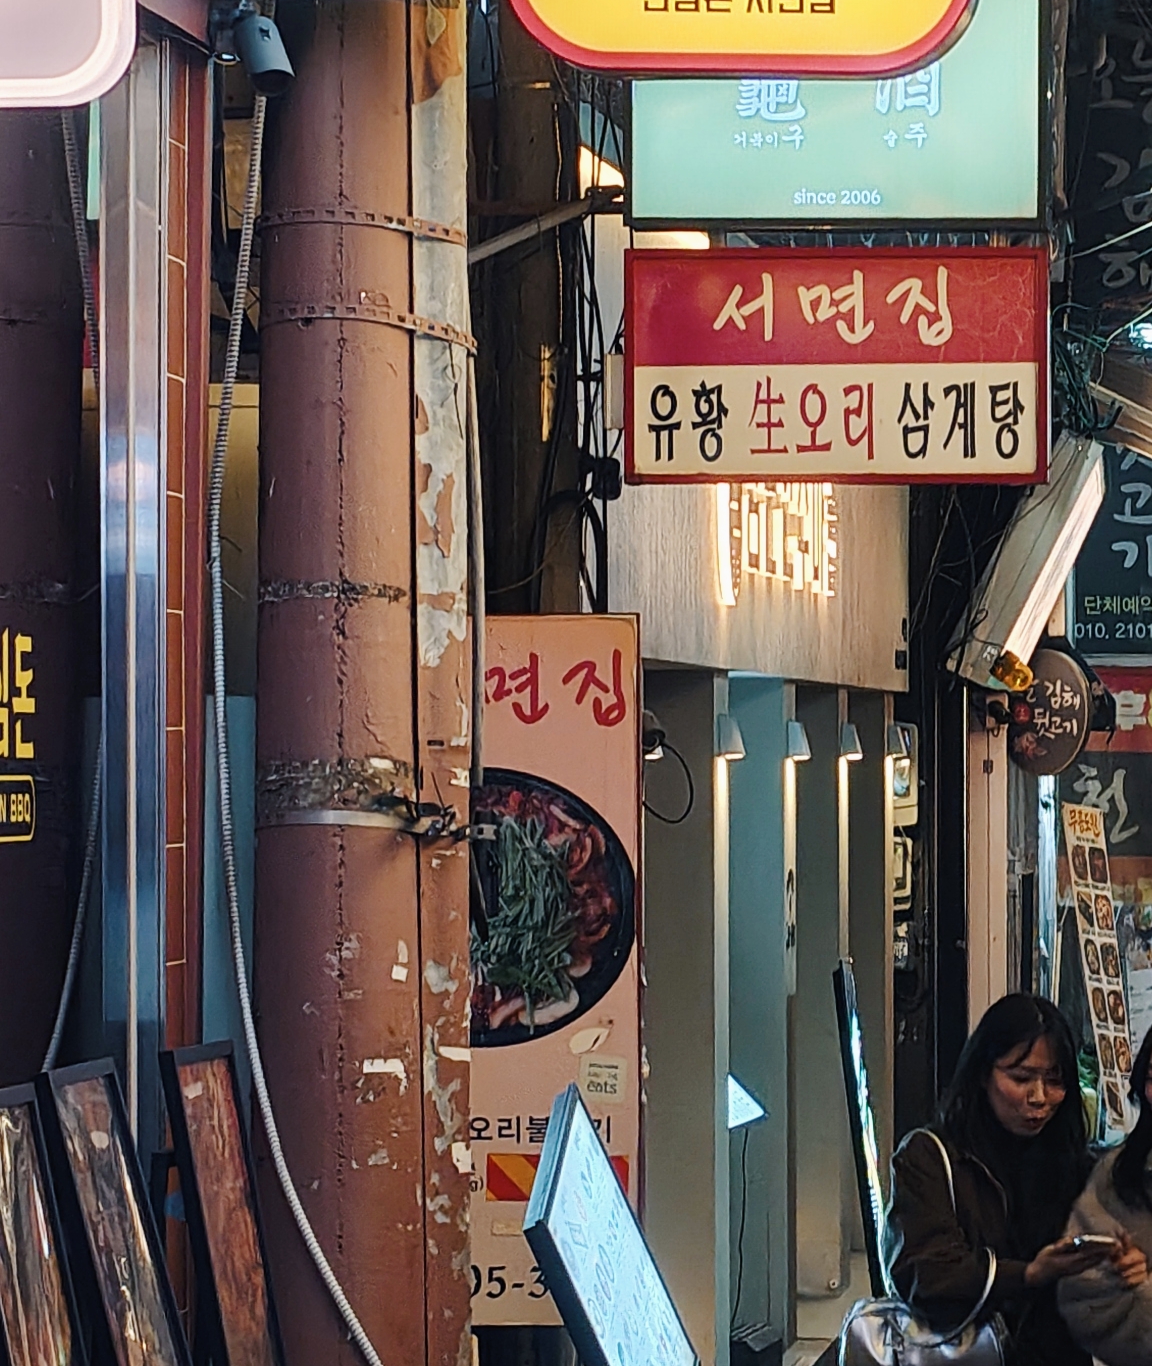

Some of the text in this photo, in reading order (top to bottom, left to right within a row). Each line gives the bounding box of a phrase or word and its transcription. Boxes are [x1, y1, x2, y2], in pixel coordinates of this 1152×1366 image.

[793, 187, 881, 206] since 2006
[712, 265, 954, 347] 서면집
[647, 380, 729, 463] 유황
[897, 380, 1026, 461] 삼계탕
[10, 793, 32, 825] BBQ
